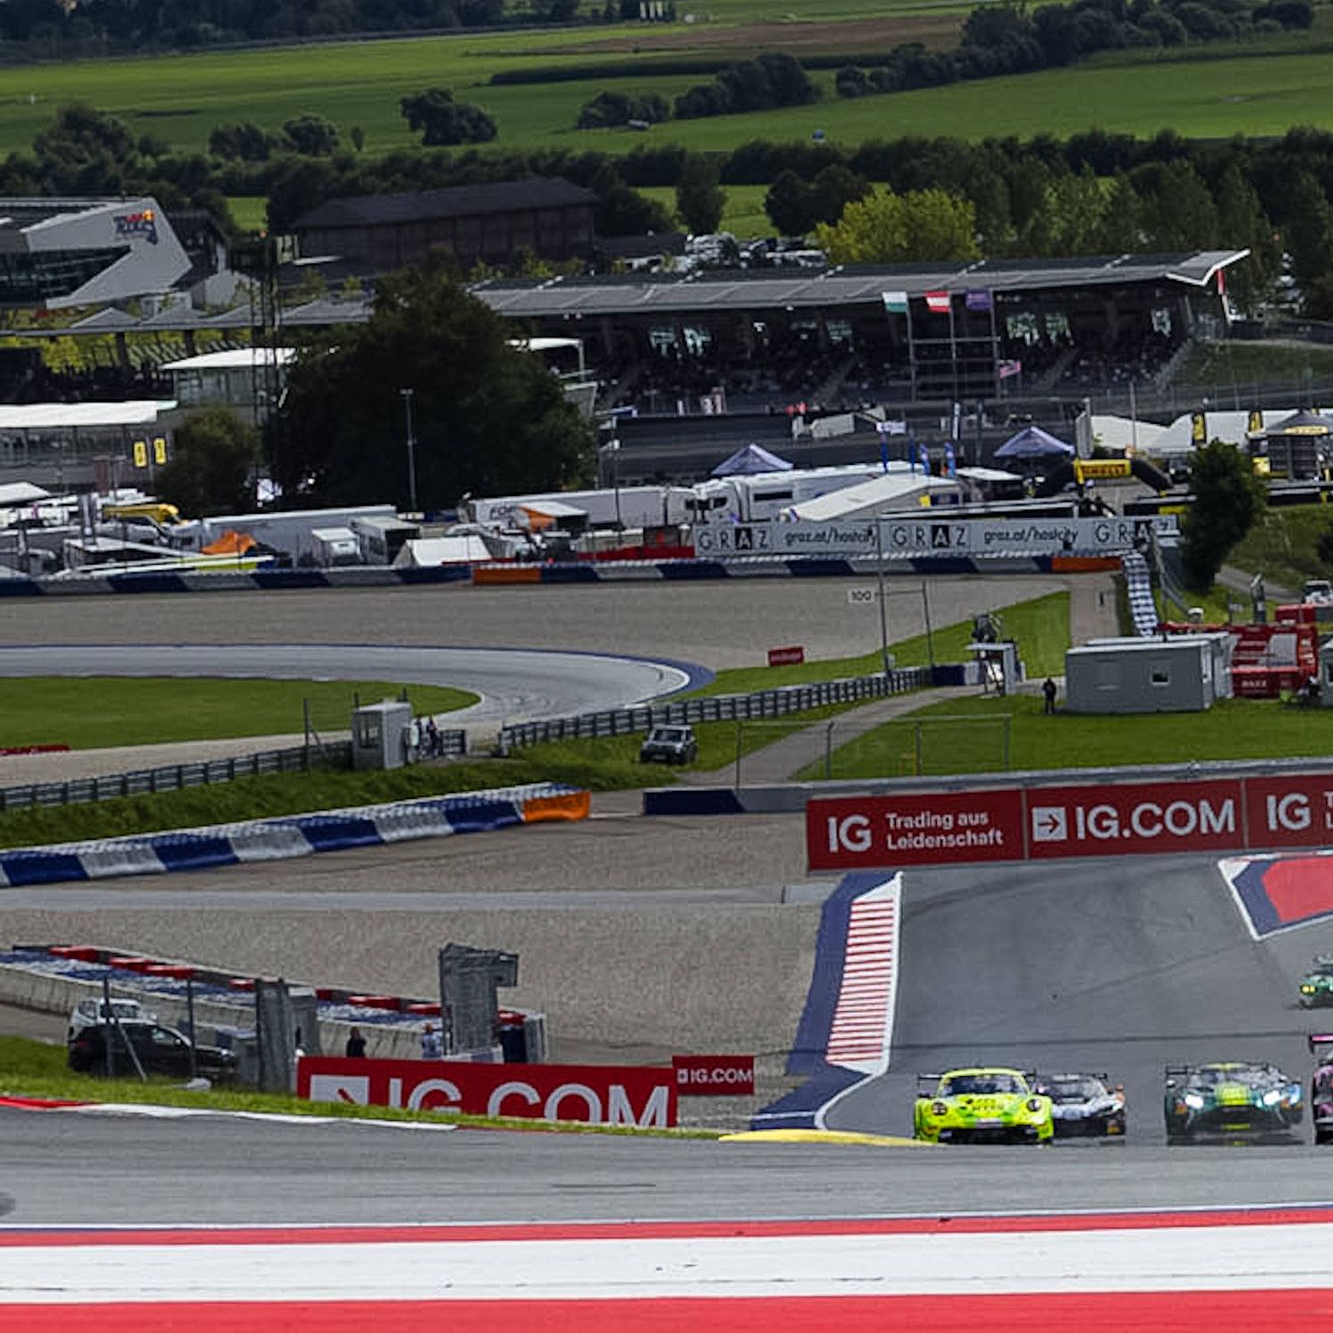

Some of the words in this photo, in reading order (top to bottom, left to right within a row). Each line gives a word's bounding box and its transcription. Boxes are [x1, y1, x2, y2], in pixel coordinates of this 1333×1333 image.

[700, 529, 768, 550] GRAZ
[892, 527, 967, 547] GRAZ
[885, 811, 953, 830] Trading
[957, 812, 989, 827] aus
[1076, 798, 1236, 840] IG.COM
[1266, 793, 1312, 830] IG
[828, 814, 873, 852] IG
[886, 828, 1004, 850] Leidenschaft
[690, 1068, 754, 1085] IG.COM
